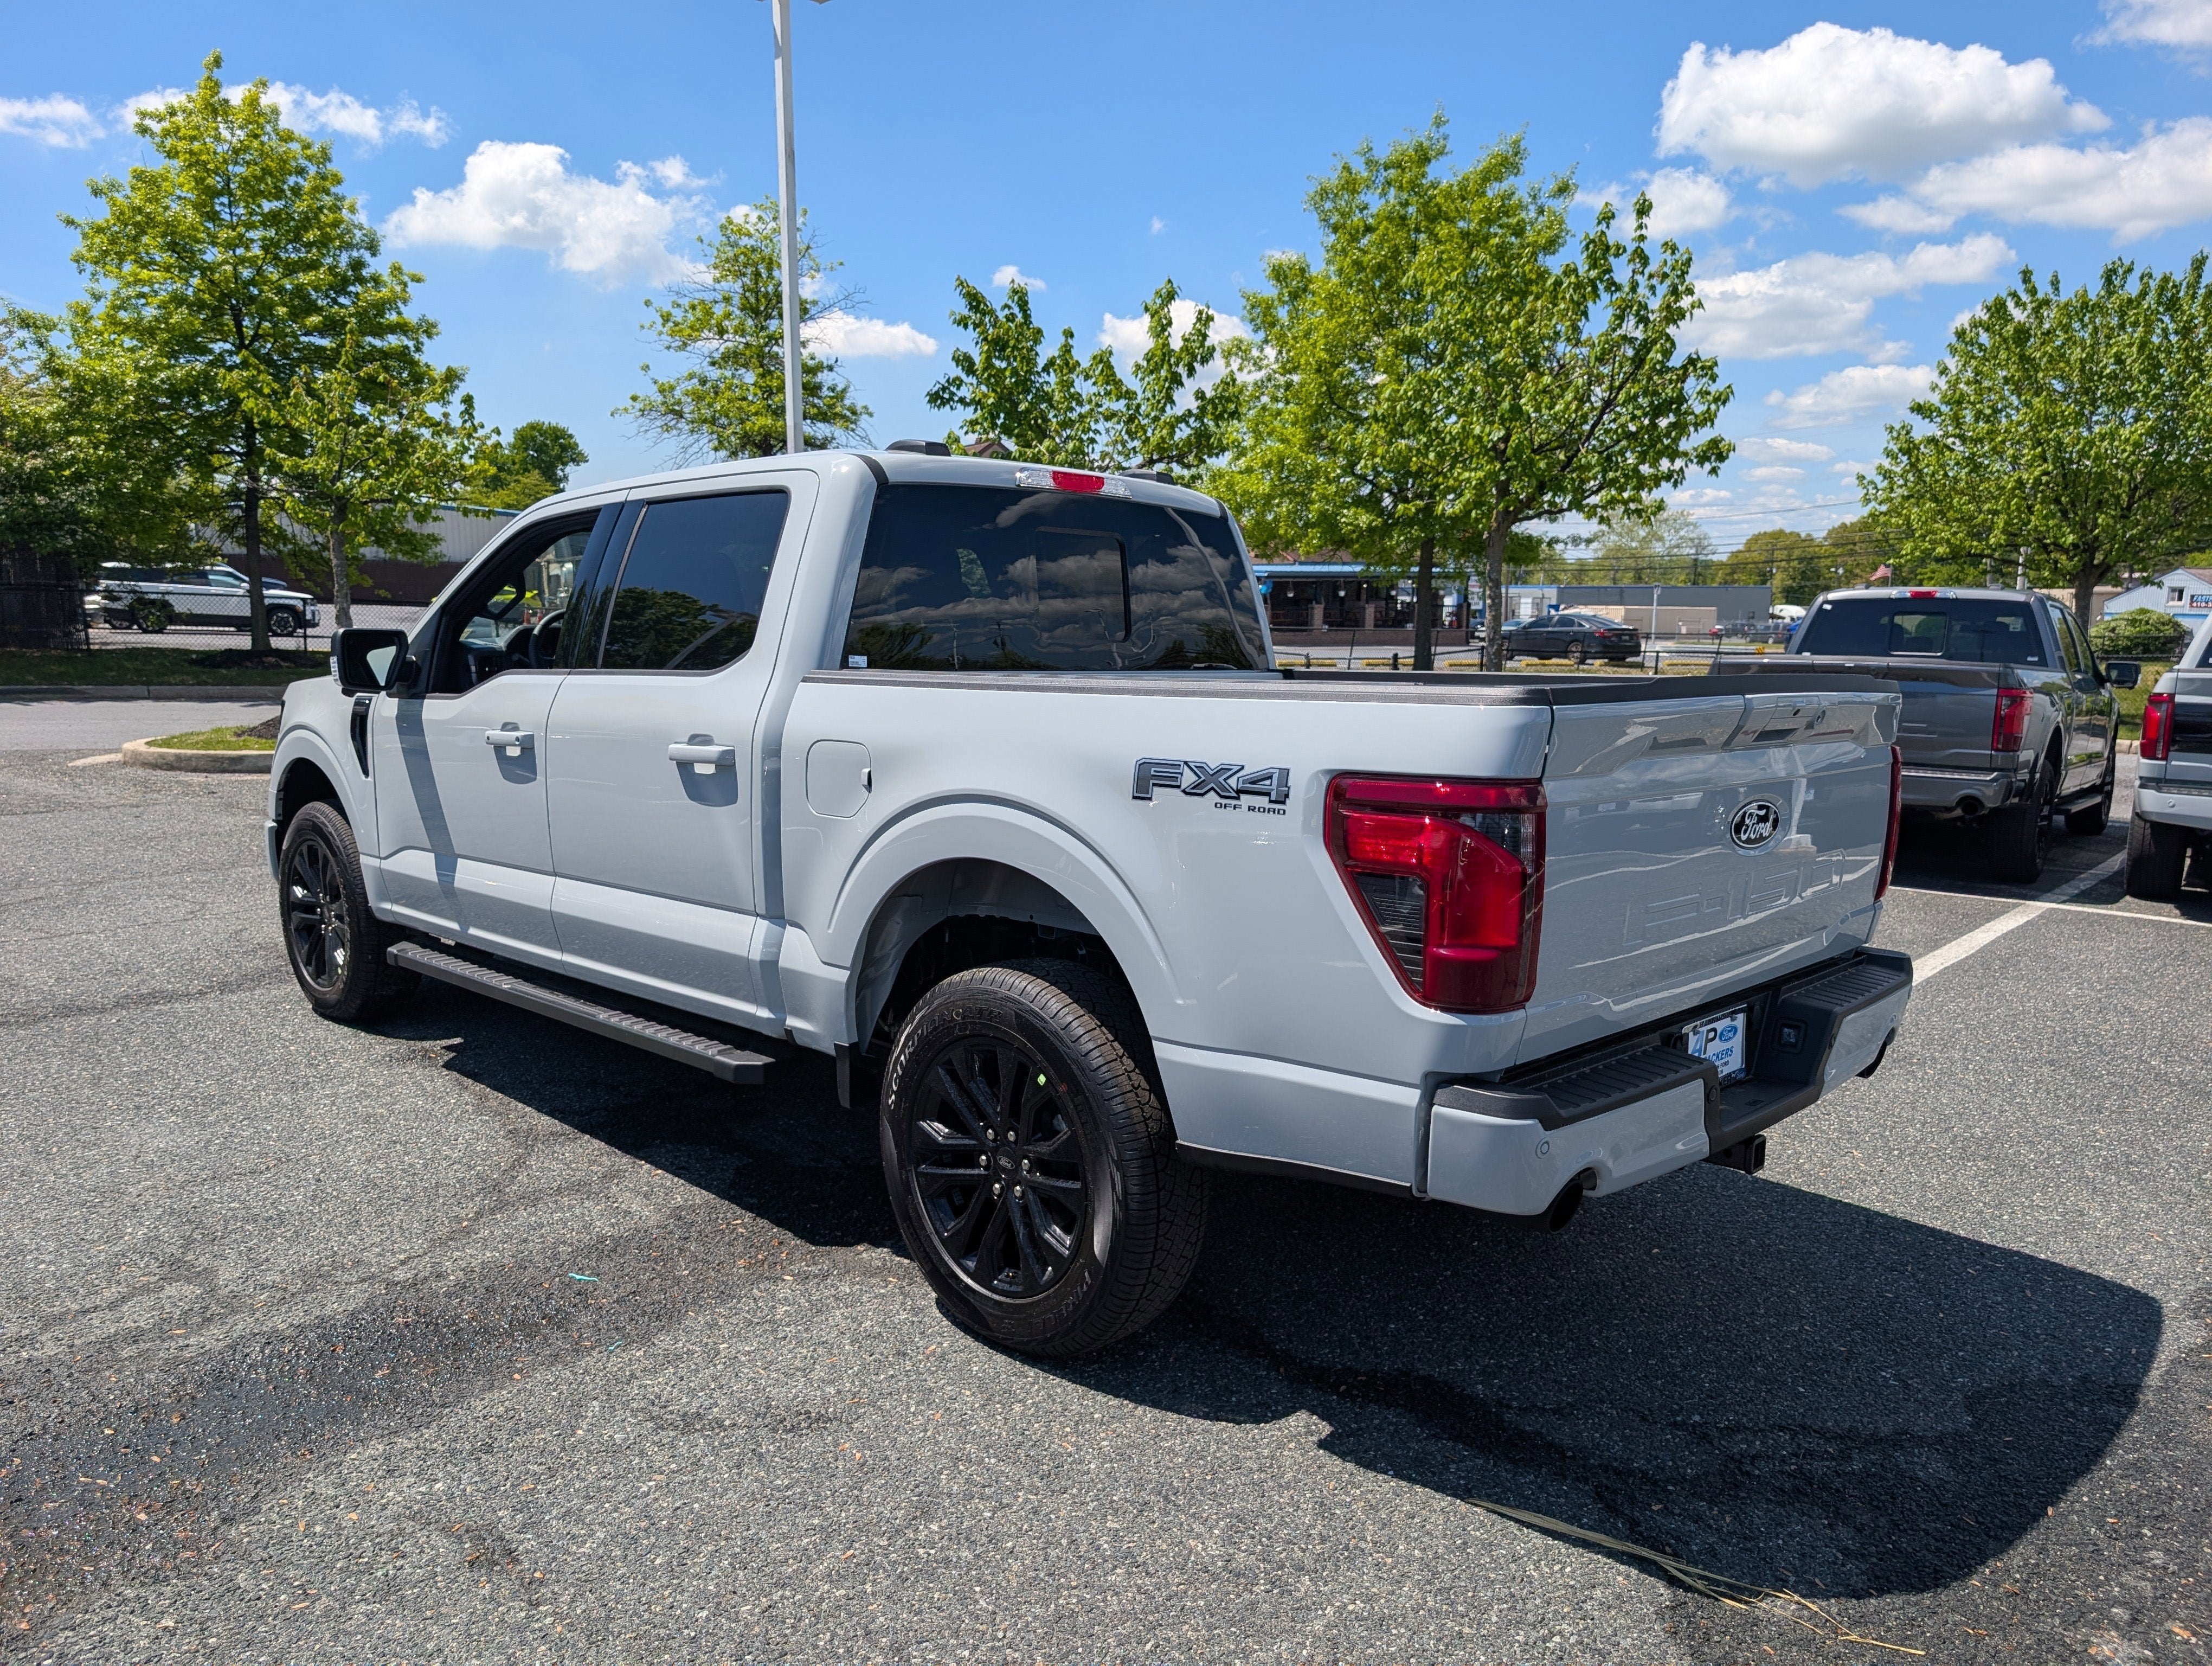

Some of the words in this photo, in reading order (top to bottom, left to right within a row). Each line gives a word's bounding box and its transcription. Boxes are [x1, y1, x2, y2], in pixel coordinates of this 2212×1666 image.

[1131, 757, 1291, 805] FX4
[1214, 802, 1243, 811] OFF
[1248, 805, 1287, 816] ROAD
[1740, 809, 1774, 841] Ford
[1721, 1027, 1735, 1041] Ford
[888, 1009, 954, 1110] SCORPION
[1704, 1046, 1734, 1063] ACKERS
[1000, 1157, 1012, 1168] Ford
